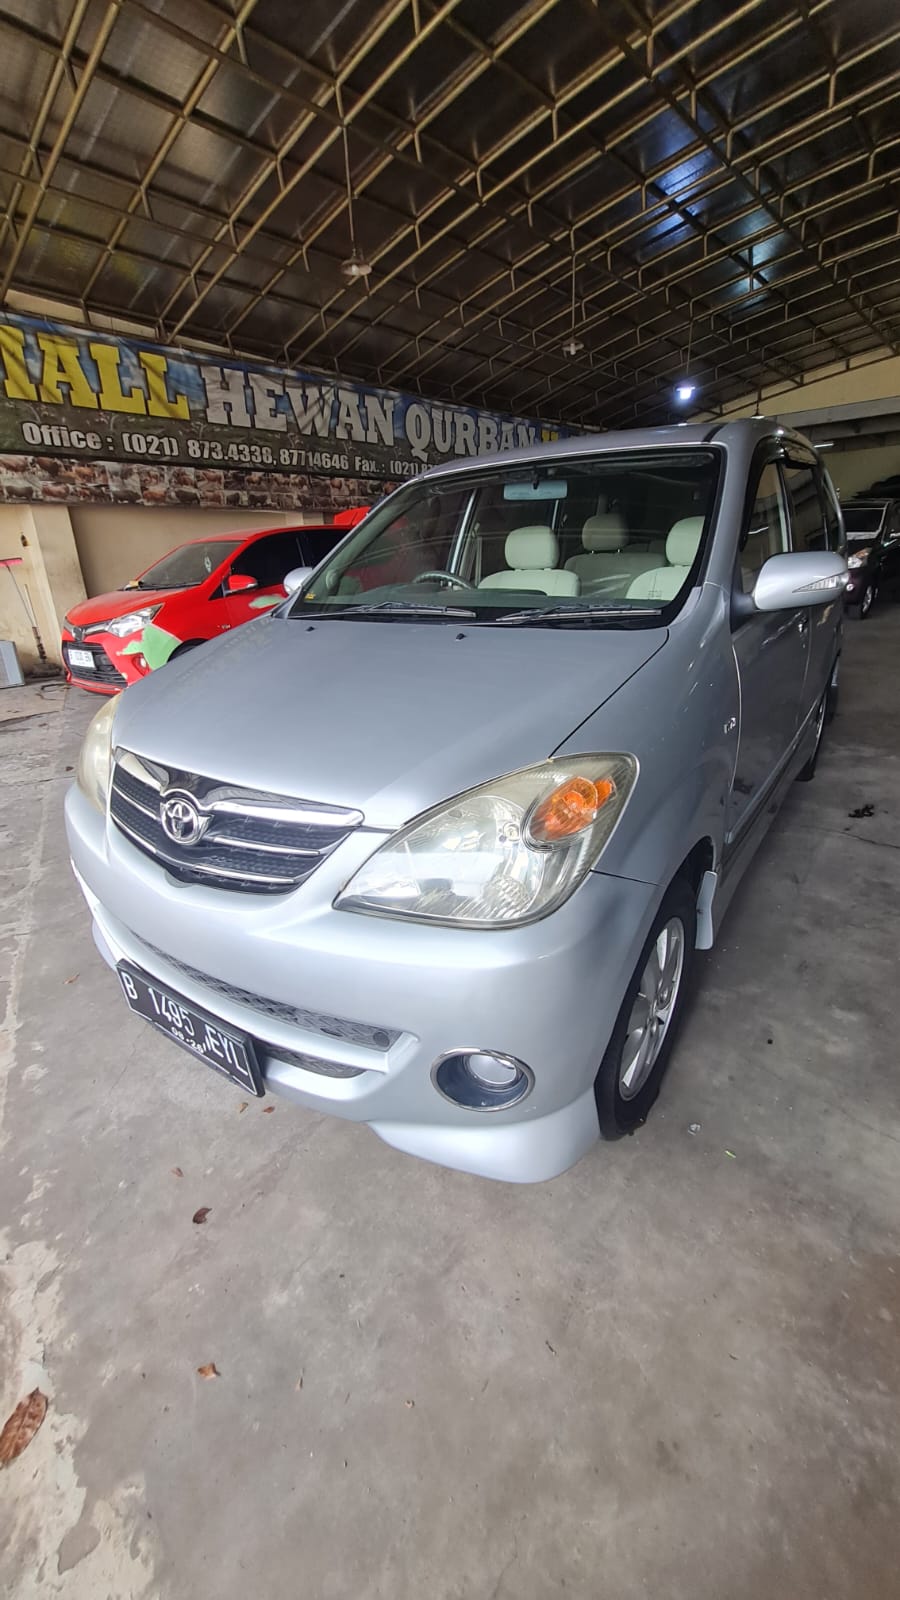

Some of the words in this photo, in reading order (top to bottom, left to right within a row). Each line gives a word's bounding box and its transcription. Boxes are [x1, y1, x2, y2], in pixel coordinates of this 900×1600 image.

[22, 422, 102, 450] Office
[122, 433, 179, 456] (021)
[280, 449, 349, 470] 87714646
[390, 460, 419, 476] (021)
[201, 366, 394, 447] HEWAN
[405, 403, 536, 462] QURBAN
[121, 972, 138, 999] B
[148, 987, 194, 1036] 1495
[205, 1024, 249, 1076] EYL
